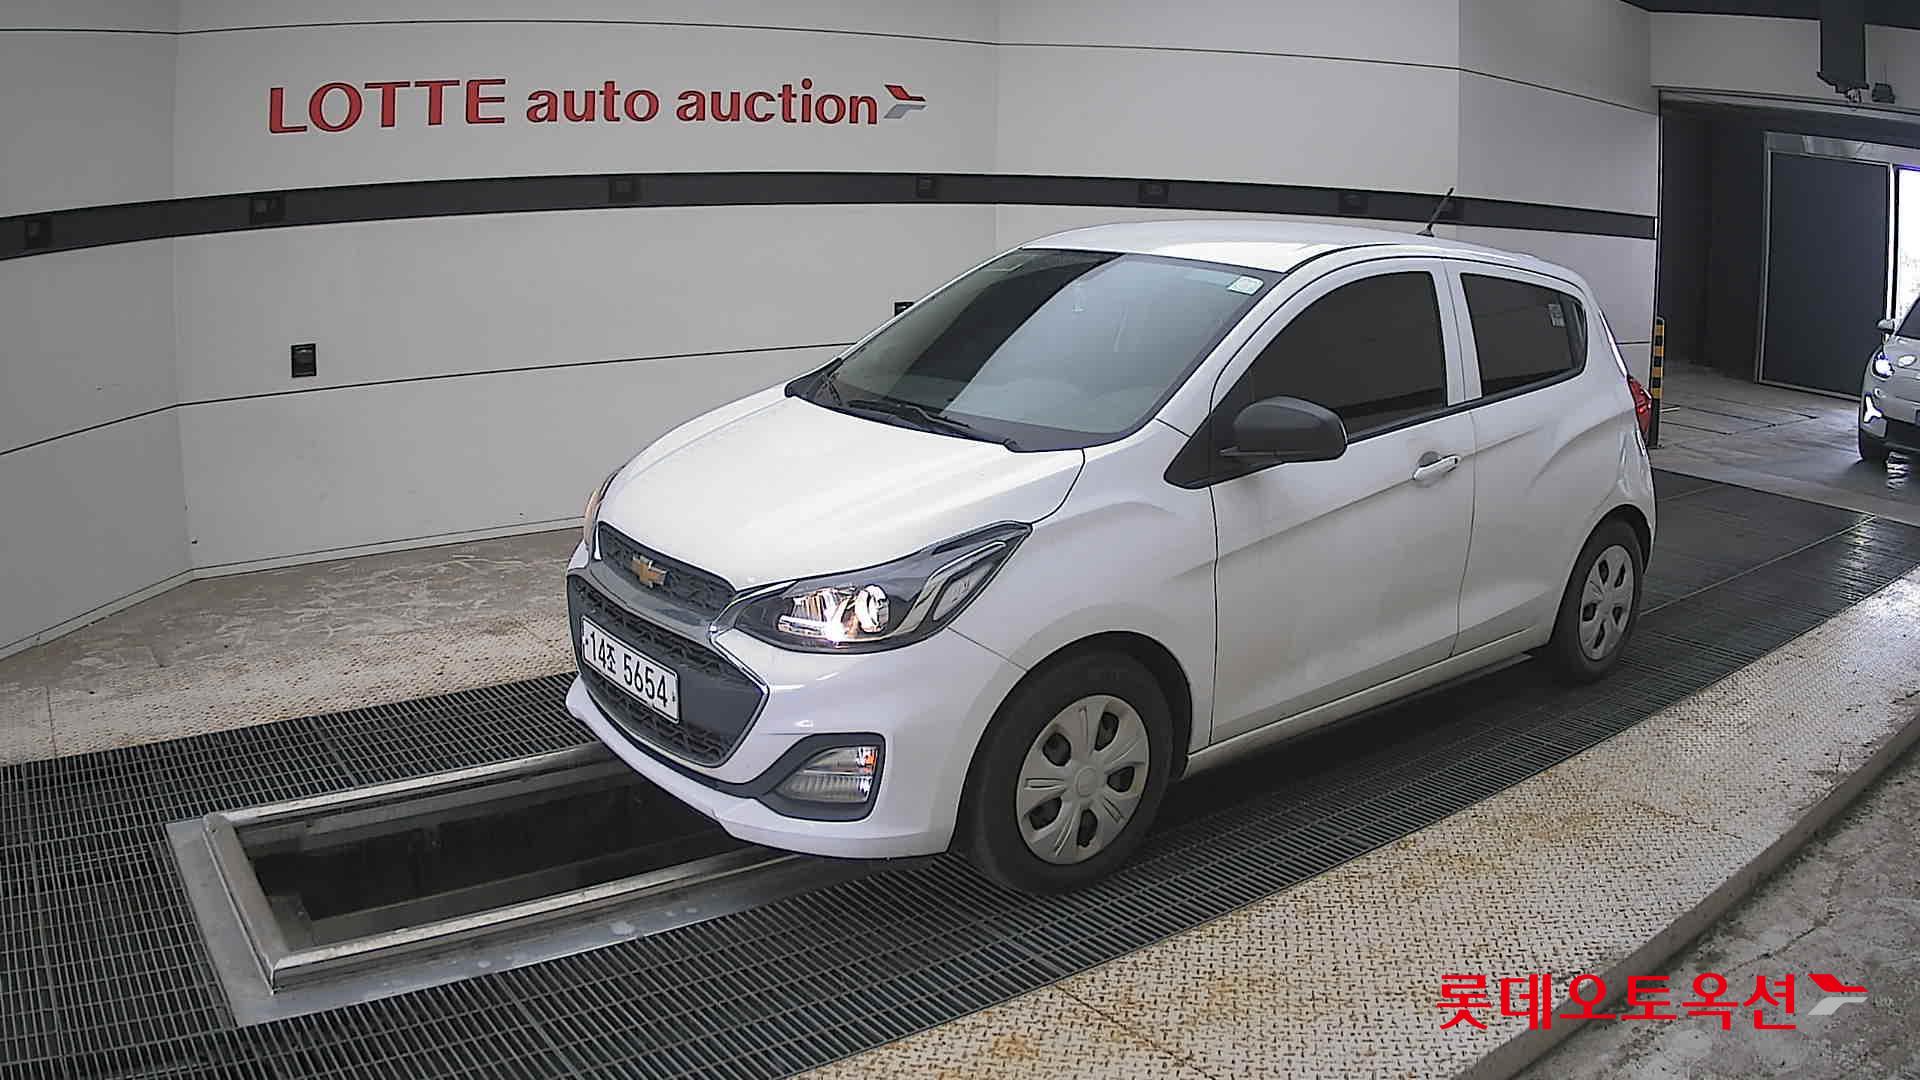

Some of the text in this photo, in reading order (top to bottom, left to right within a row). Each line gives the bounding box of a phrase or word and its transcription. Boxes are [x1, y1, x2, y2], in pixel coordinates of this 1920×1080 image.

[269, 77, 878, 134] LOTTE auto auction
[590, 631, 668, 708] 14조 5654
